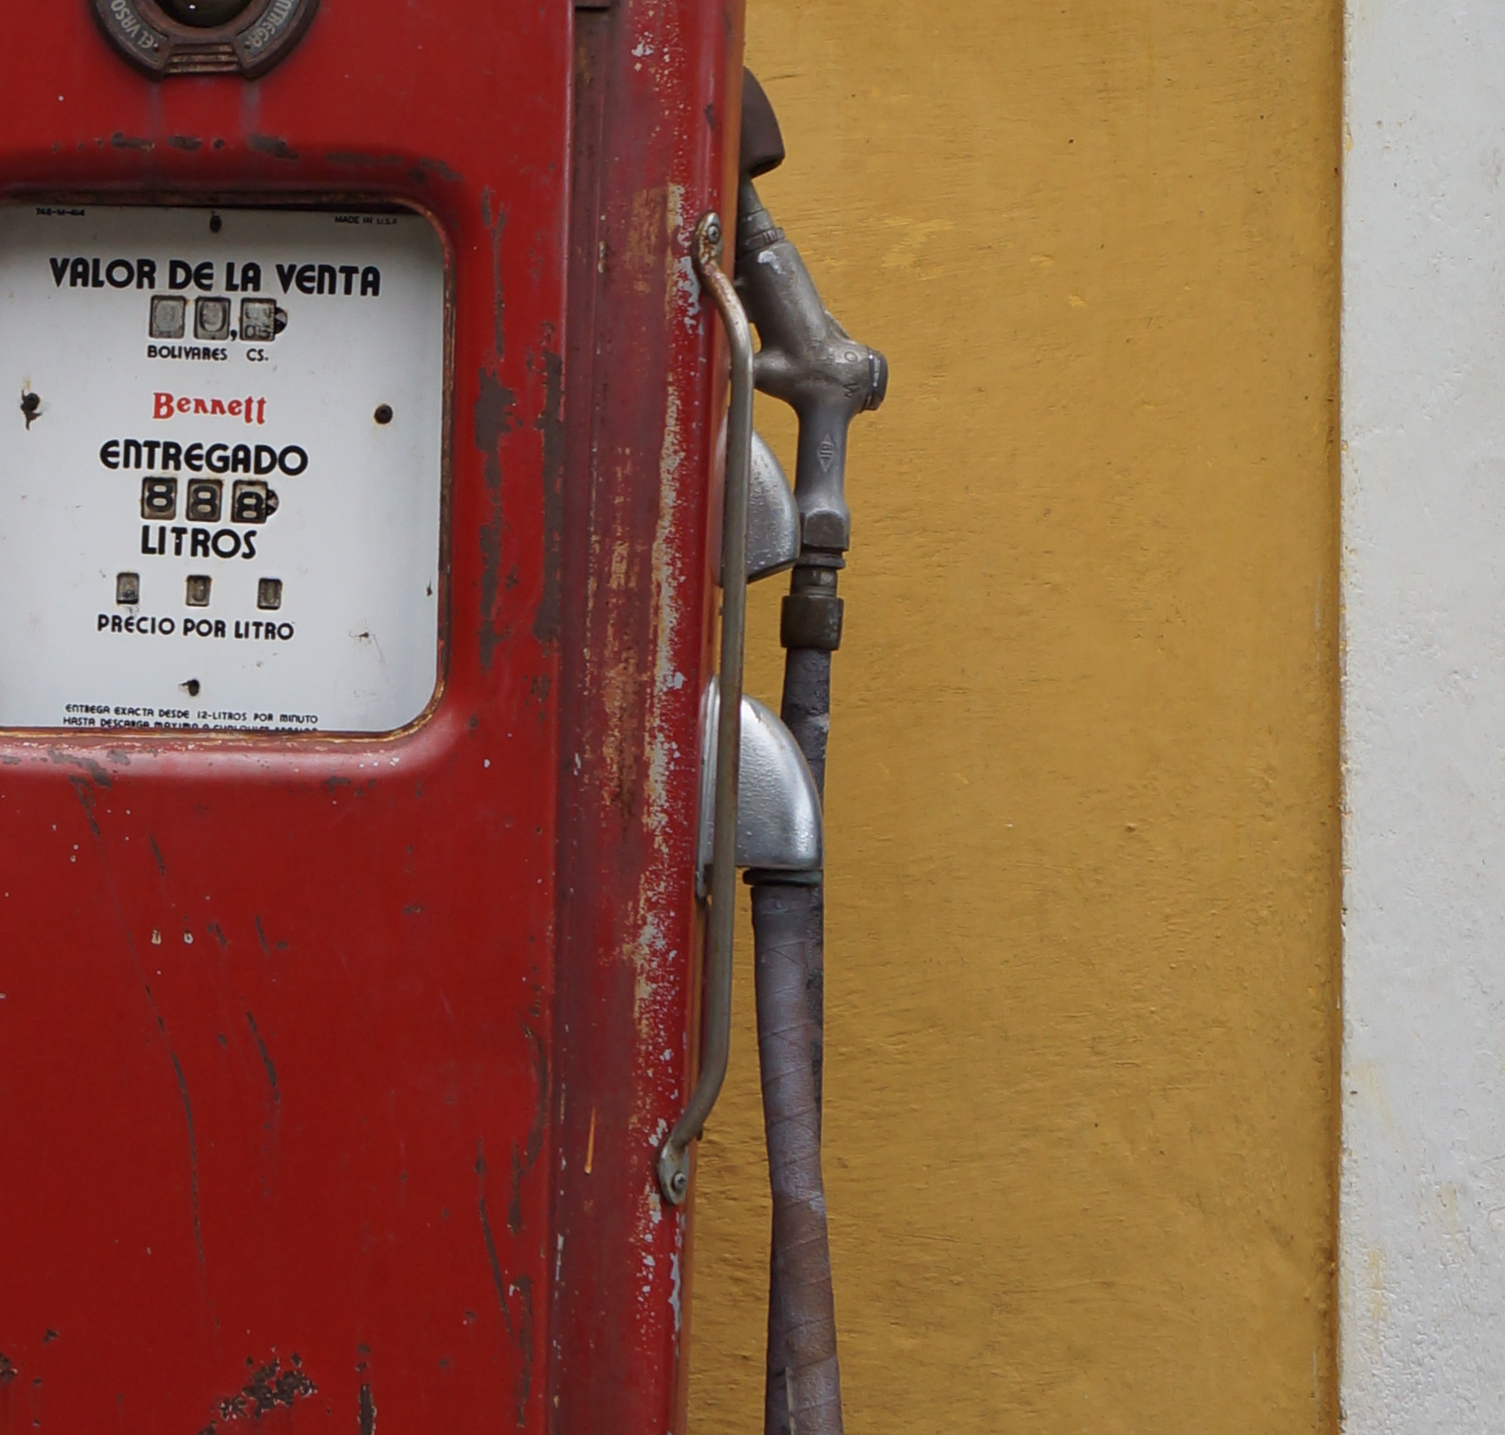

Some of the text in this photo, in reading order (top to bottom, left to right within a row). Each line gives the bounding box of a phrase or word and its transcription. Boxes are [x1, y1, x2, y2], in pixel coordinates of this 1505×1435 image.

[49, 257, 381, 296] VALOR DE LA VENTA
[147, 345, 228, 361] BOLIVARES
[152, 392, 267, 425] Bennett
[100, 439, 309, 476] ENTREGADO
[141, 525, 257, 560] LITROS
[97, 614, 295, 641] PRECIO POR LITRO
[63, 716, 96, 727] HASTA
[65, 704, 110, 715] ENTREGA
[114, 706, 155, 717] EXACTA
[158, 709, 190, 719] DESDE
[253, 713, 274, 723] POR
[279, 714, 319, 724] MINUTO
